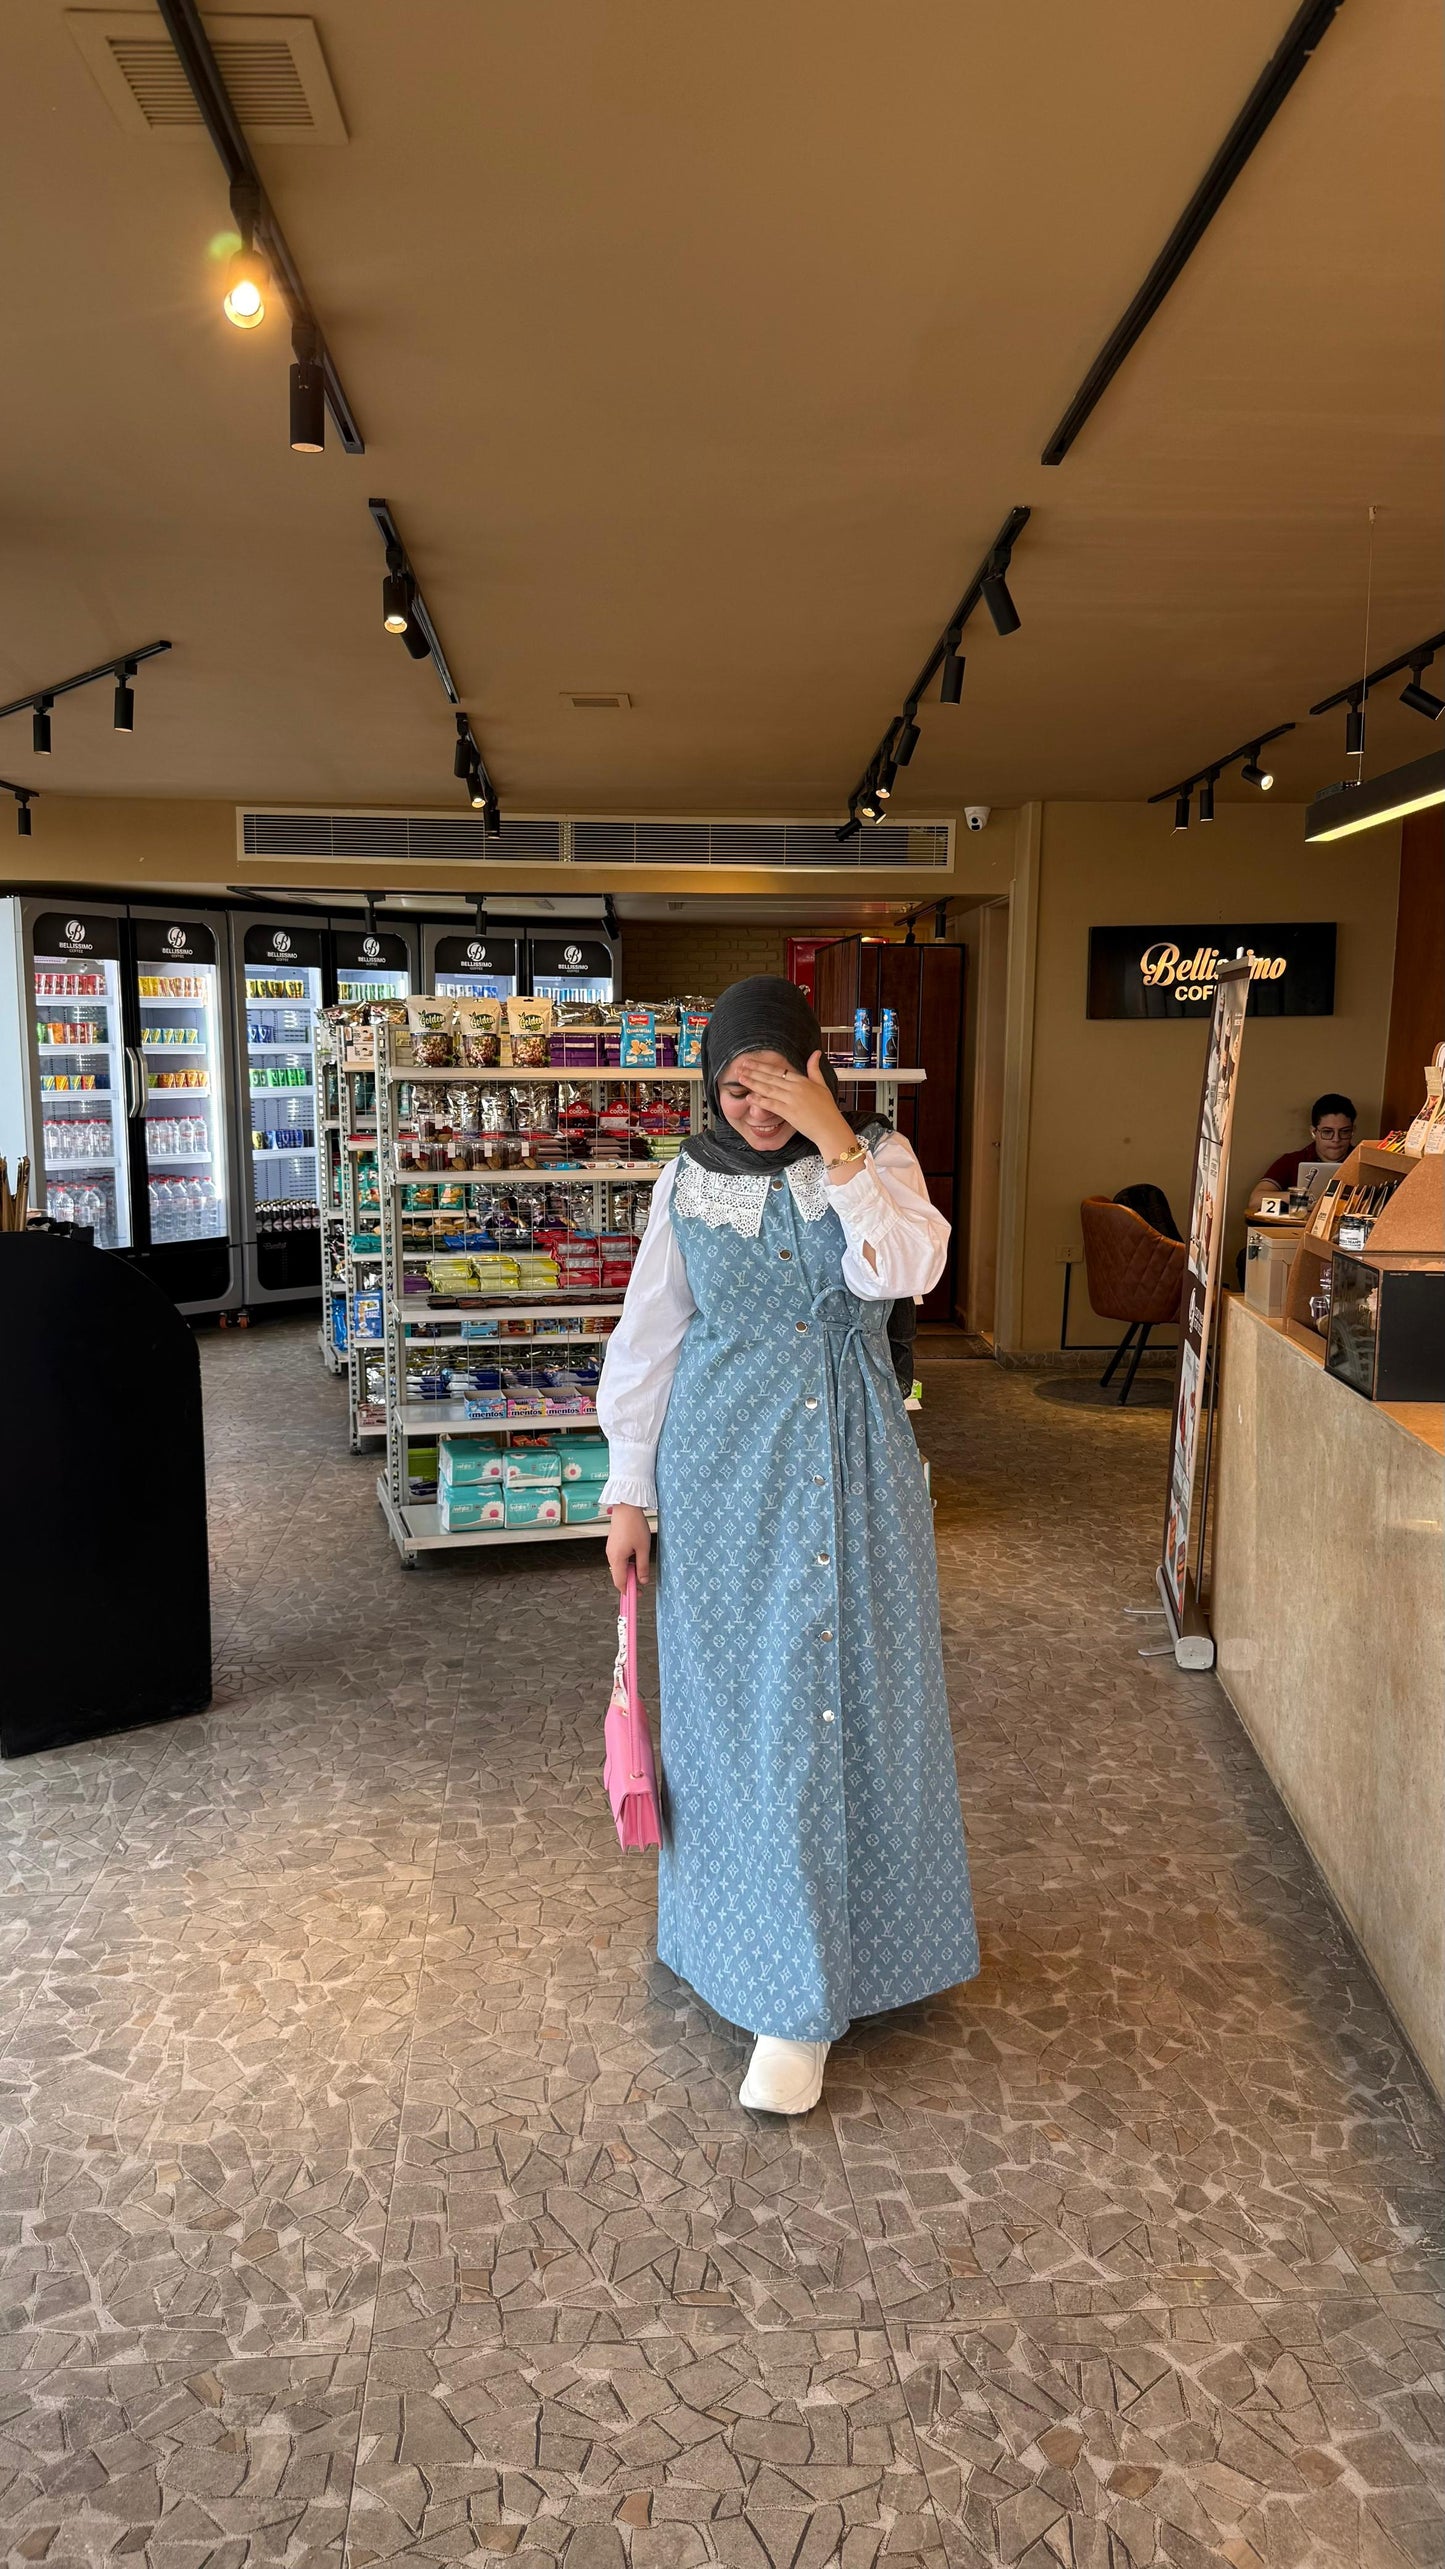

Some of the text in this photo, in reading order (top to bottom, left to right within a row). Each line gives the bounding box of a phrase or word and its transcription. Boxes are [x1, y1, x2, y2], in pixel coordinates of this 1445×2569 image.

[59, 942, 93, 950] BELLISSIMO
[162, 947, 193, 955] BELLISSIMO
[460, 960, 492, 968] BELLISSIMO
[558, 963, 588, 971] BELLISSIMO
[1140, 942, 1287, 987] Bellimo
[420, 1014, 446, 1029] Golden
[470, 1015, 495, 1030] Golden
[519, 1015, 545, 1030] Golden
[1266, 1200, 1276, 1213] 2
